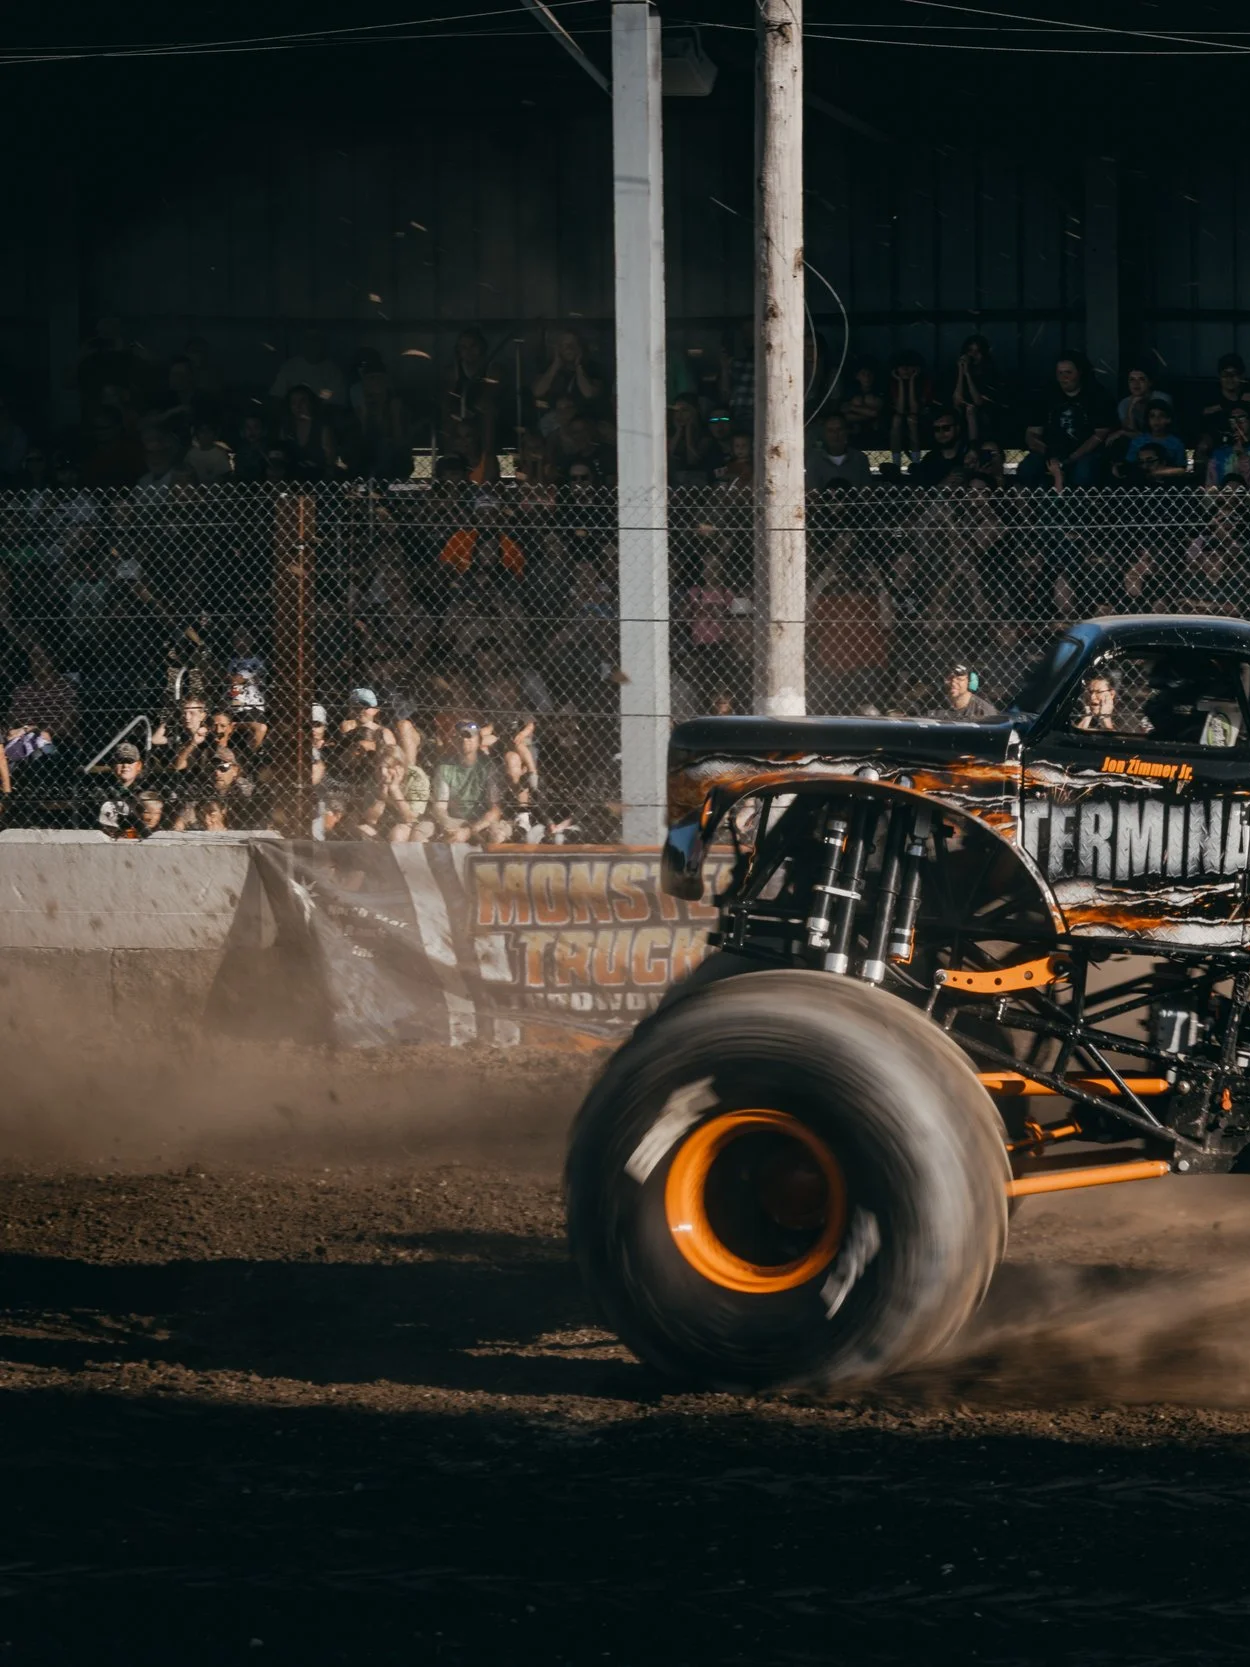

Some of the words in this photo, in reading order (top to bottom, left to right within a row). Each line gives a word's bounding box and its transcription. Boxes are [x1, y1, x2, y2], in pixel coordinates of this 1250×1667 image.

[1101, 756, 1126, 773] Jon
[1126, 759, 1178, 778] Zimmer
[1178, 763, 1193, 780] Jr.
[475, 861, 734, 926] MONSTE
